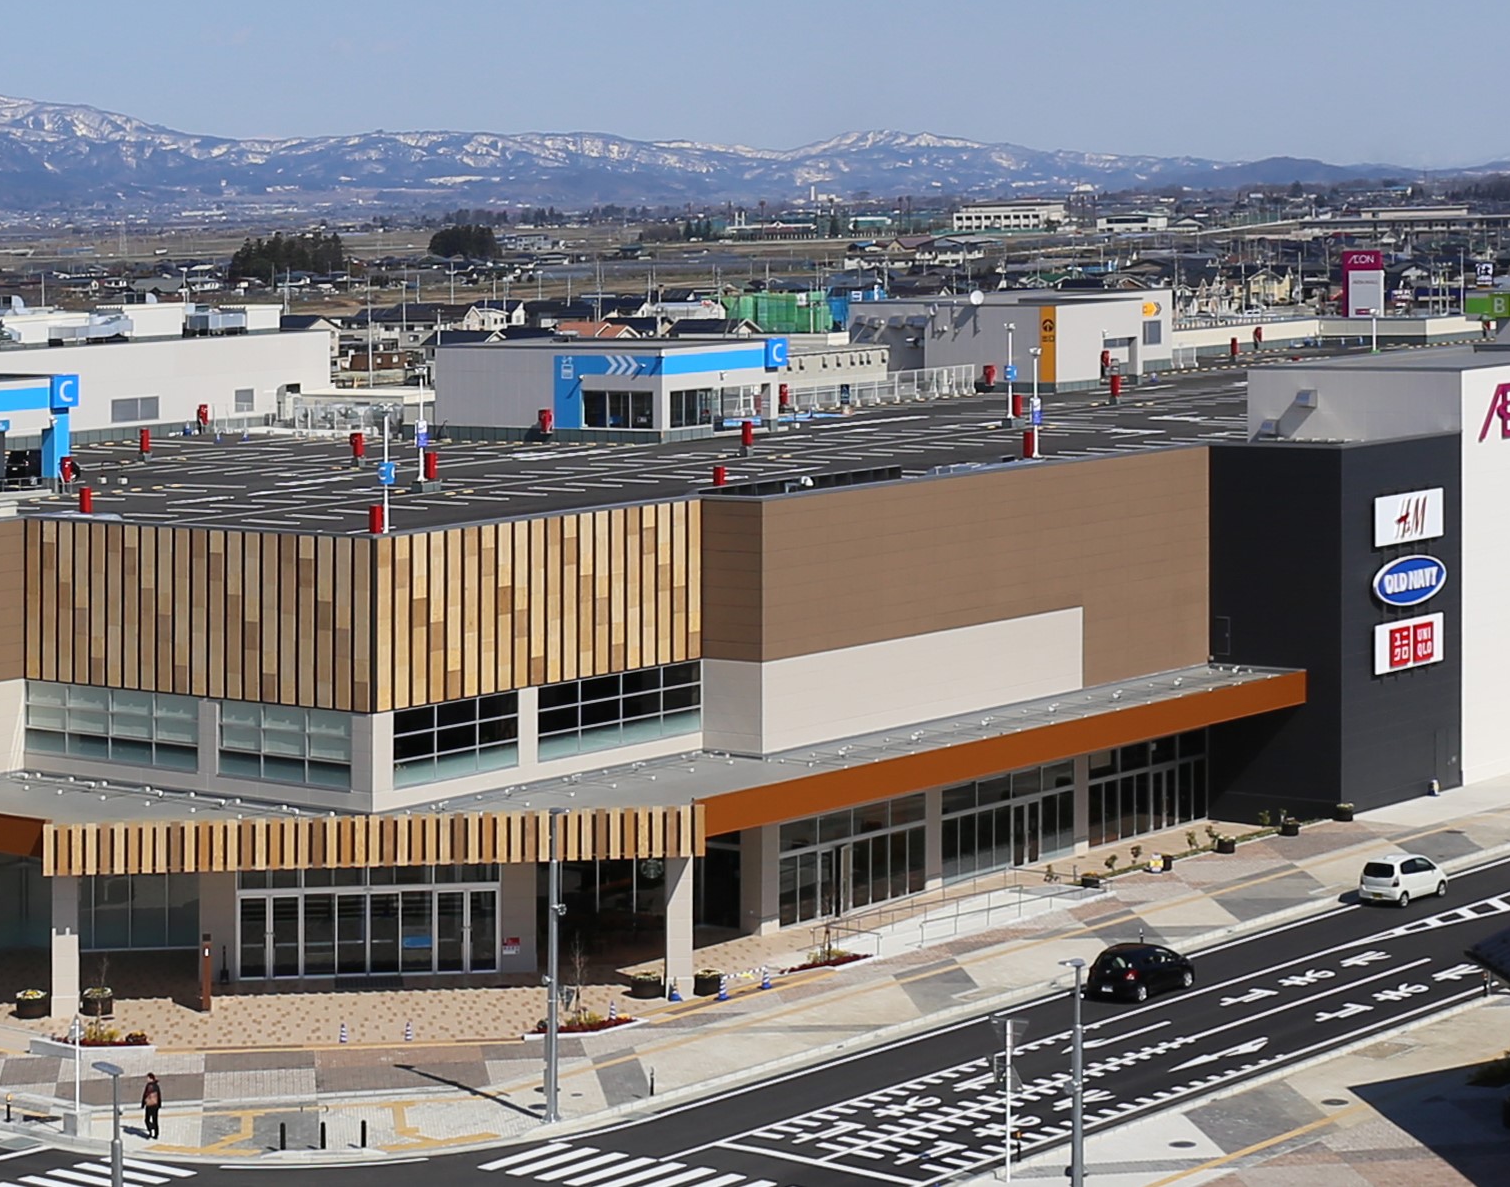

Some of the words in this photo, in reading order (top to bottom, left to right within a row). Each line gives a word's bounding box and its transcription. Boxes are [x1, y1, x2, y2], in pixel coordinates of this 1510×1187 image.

[1493, 297, 1506, 313] B
[772, 343, 783, 362] C
[59, 380, 74, 402] C
[1384, 571, 1408, 595] OLD
[1408, 566, 1439, 591] NAVY
[1417, 626, 1432, 642] UNI
[1416, 641, 1433, 659] QLO
[1219, 950, 1392, 1007] 止まれ
[1315, 963, 1484, 1023] 止まれ
